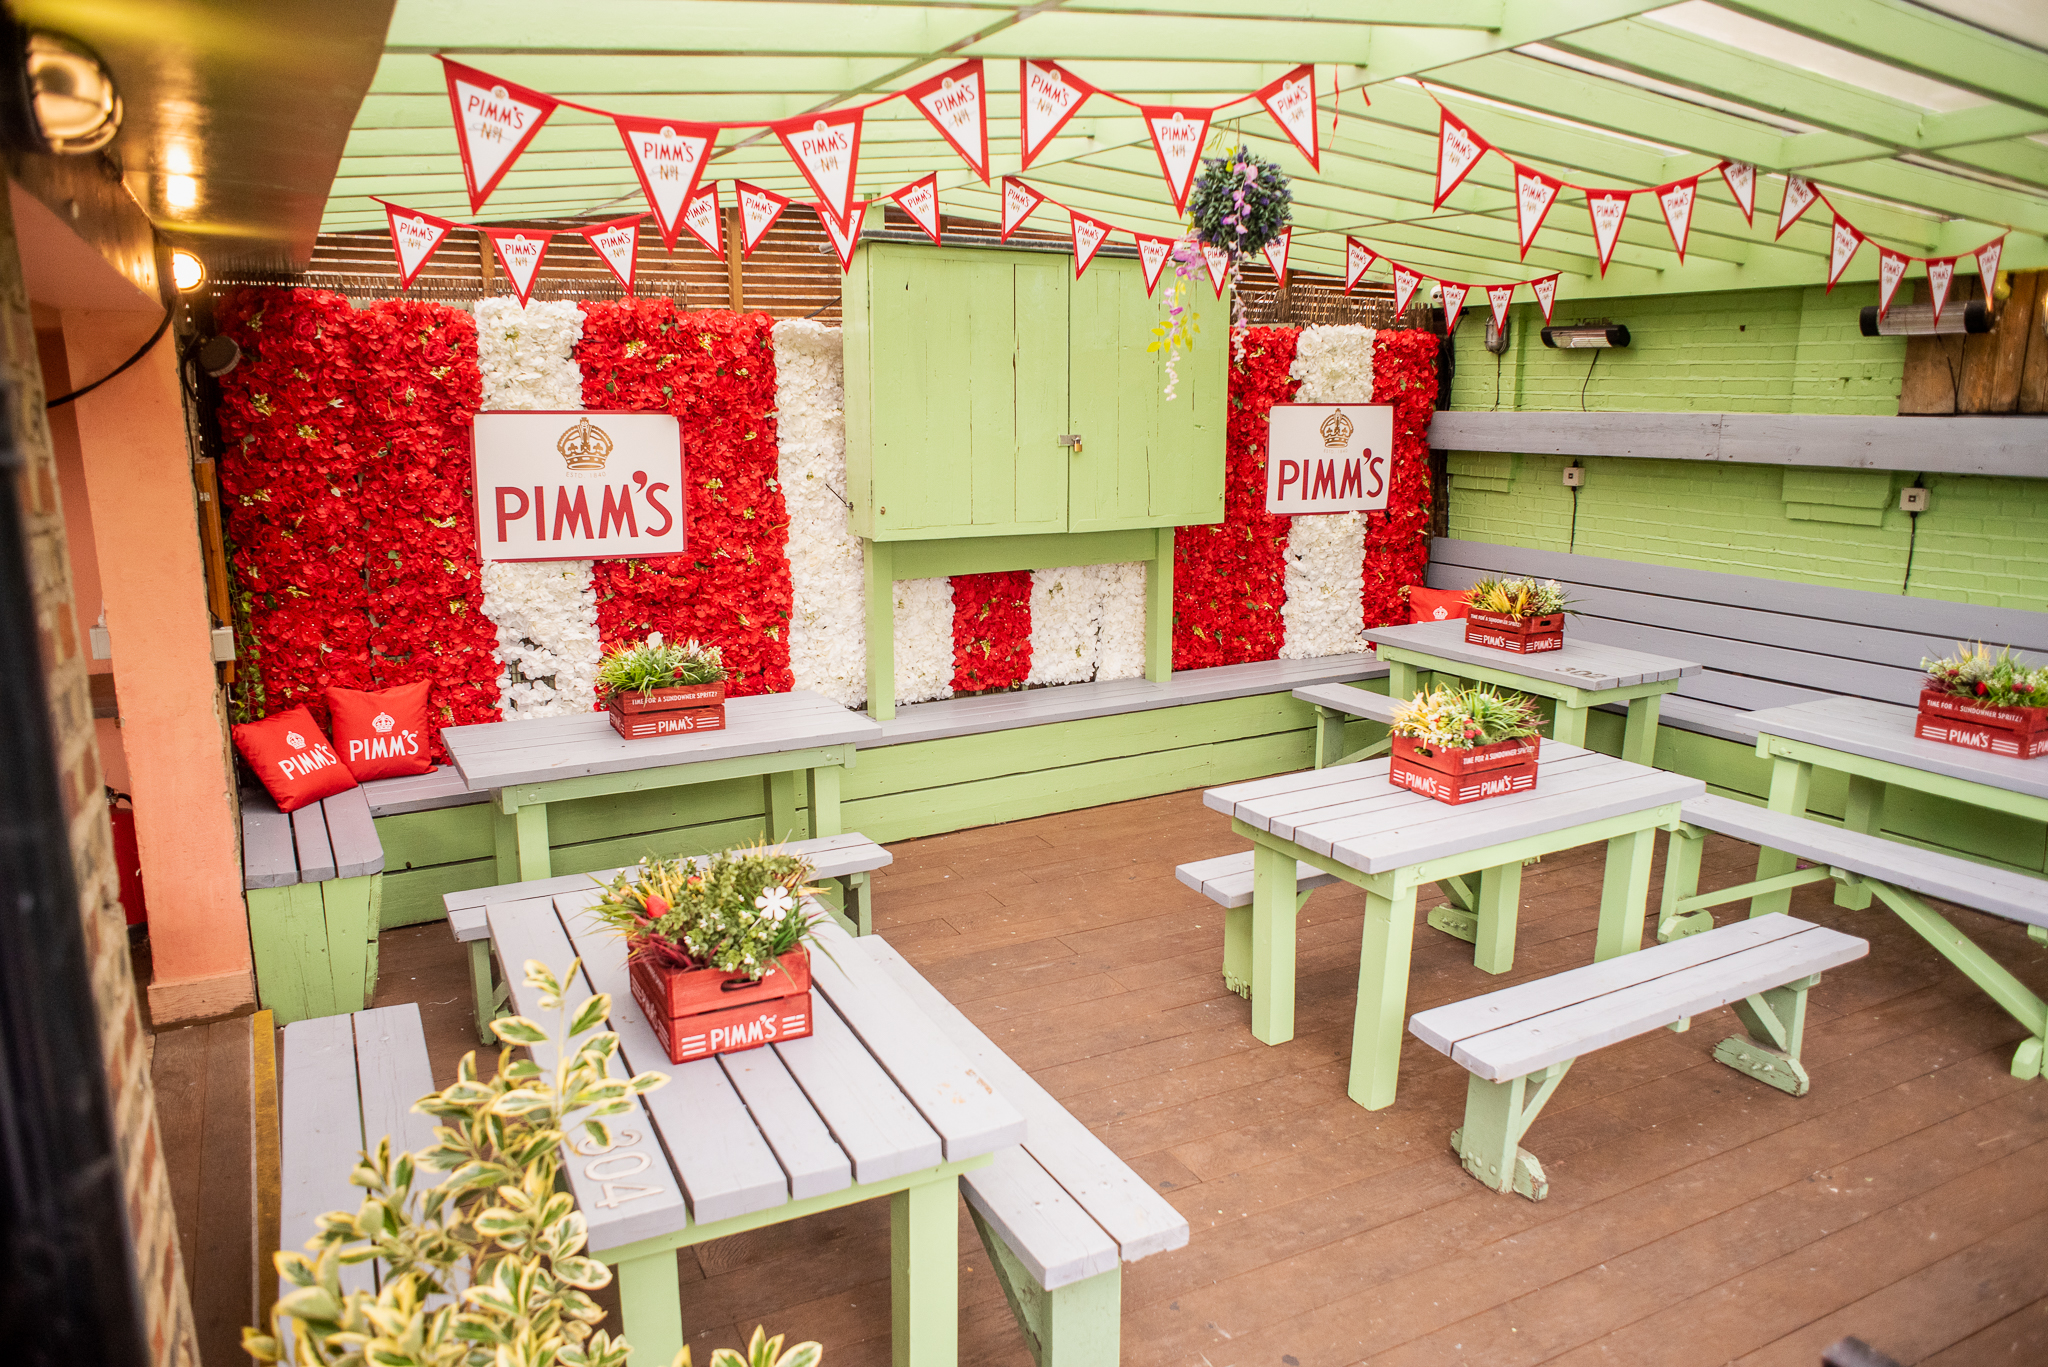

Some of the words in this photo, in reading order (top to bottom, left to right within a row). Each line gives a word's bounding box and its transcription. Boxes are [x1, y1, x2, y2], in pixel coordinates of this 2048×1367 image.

[934, 84, 975, 115] PIMM'S
[1031, 74, 1070, 107] PIMM'S
[1277, 85, 1308, 114] PIMM'S
[468, 95, 524, 130] PIMM'S
[802, 130, 848, 156] PIMM'S
[1161, 124, 1196, 141] PIMM'S
[644, 141, 694, 163] PIMM'S
[1446, 132, 1472, 160] PIMM'S
[907, 189, 932, 208] PIMM'S
[1008, 188, 1030, 207] PIMM'S
[1522, 183, 1547, 204] PIMM'S
[685, 200, 712, 221] PIMM'S
[745, 197, 773, 216] PIMM'S
[1596, 204, 1619, 218] PIMM'S
[400, 222, 434, 241] PIMM'S
[600, 232, 631, 249] PIMM'S
[1077, 225, 1099, 240] PIMM'S
[505, 243, 537, 255] PIMM'S
[1143, 245, 1164, 257] PIMM'S
[1277, 448, 1385, 501] PIMM'S
[495, 470, 673, 542] PIMM'S
[1483, 635, 1505, 647] PIMM'S
[1533, 638, 1553, 650] PIMM'S
[663, 694, 695, 702] SUNDOWNER
[1927, 700, 1940, 708] TIME
[1941, 702, 1952, 710] FOR
[1960, 706, 1996, 717] SUNDOWNER
[658, 716, 693, 732] PIMM'S
[349, 730, 419, 761] PIMM'S
[1949, 730, 1989, 748] PIMM'S
[278, 743, 337, 780] PIMM'S
[1405, 772, 1437, 794] PIMM'S
[1481, 775, 1512, 796] PIMM'S
[710, 1014, 777, 1050] PIMM'S
[576, 1129, 665, 1209] 304
